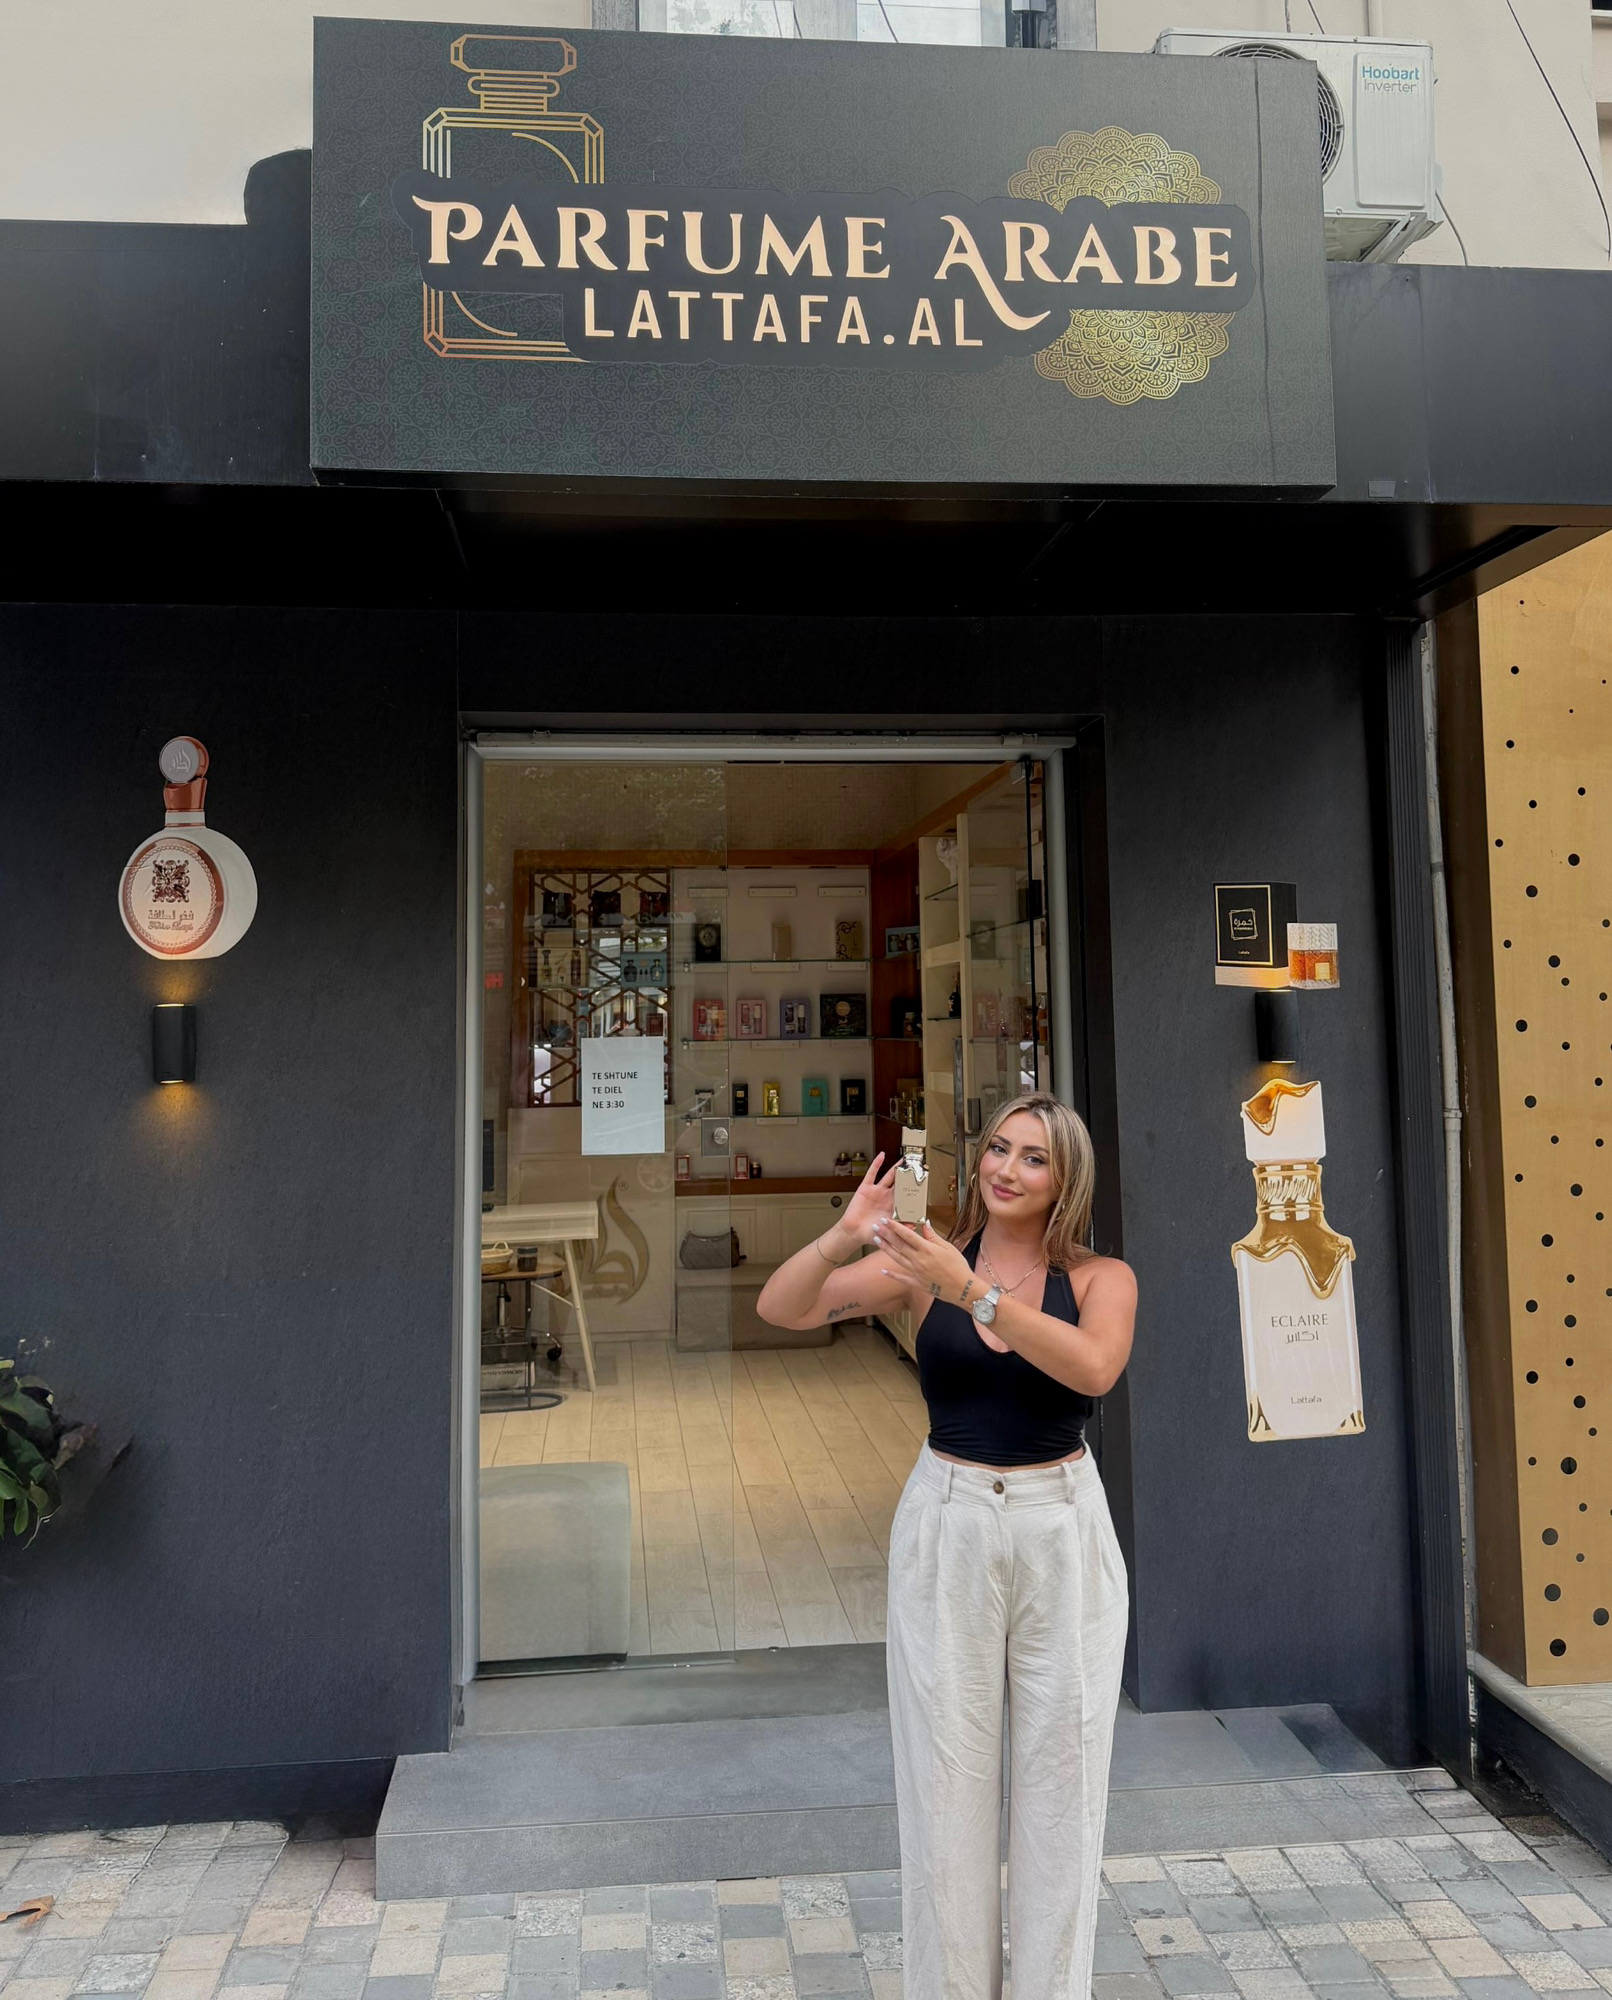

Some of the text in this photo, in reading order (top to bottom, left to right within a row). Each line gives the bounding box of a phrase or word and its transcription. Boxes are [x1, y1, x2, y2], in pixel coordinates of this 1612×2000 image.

[1362, 66, 1419, 80] Hoobart
[1364, 79, 1417, 92] Inverter
[412, 195, 1238, 331] PARFUME ARABE
[585, 288, 983, 346] LATTAFA.AL
[592, 1071, 638, 1080] TE SHTUNE
[592, 1086, 623, 1094] TE DIEL
[592, 1100, 625, 1109] NE 3:30
[1271, 1313, 1329, 1328] ECLAIRE
[1290, 1395, 1322, 1405] Lattafa
